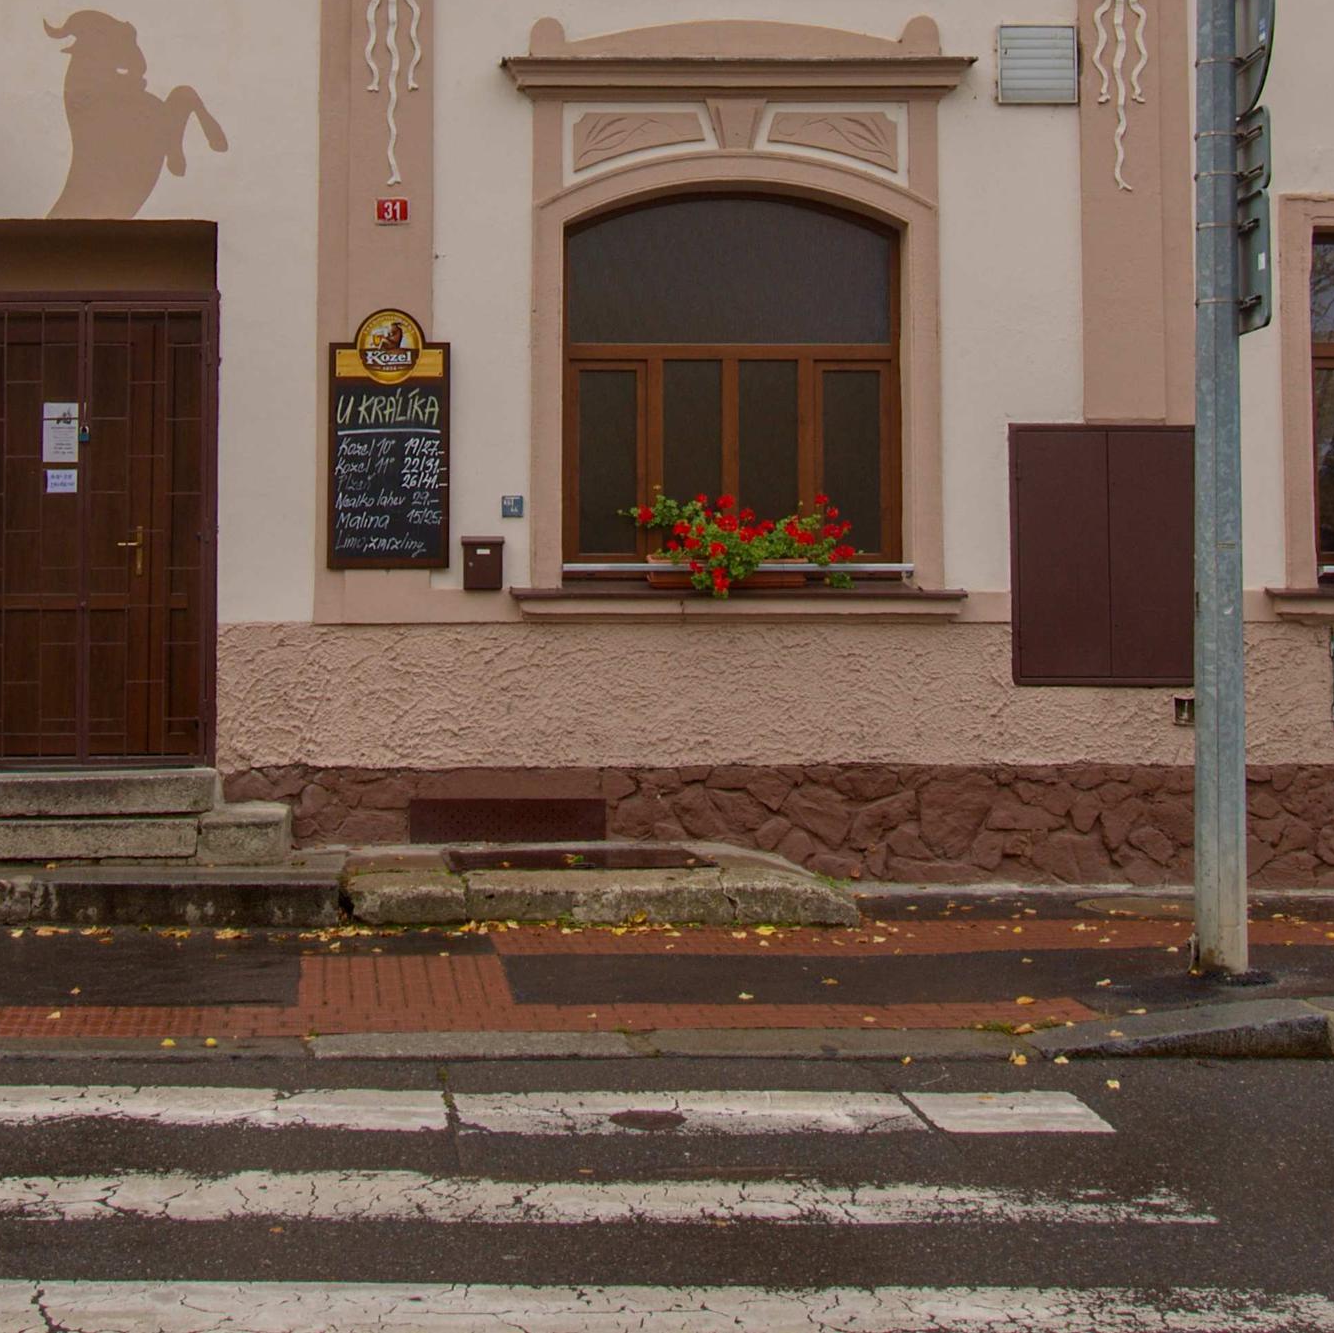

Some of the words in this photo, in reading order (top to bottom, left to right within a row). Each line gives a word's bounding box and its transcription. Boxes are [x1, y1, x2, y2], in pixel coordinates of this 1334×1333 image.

[384, 201, 400, 220] 31
[365, 350, 413, 365] Kozel
[337, 395, 355, 425] U
[358, 387, 440, 426] KRÁLÍKA
[337, 437, 375, 458] Kozel
[334, 456, 372, 476] Kozel
[336, 511, 390, 530] Malina
